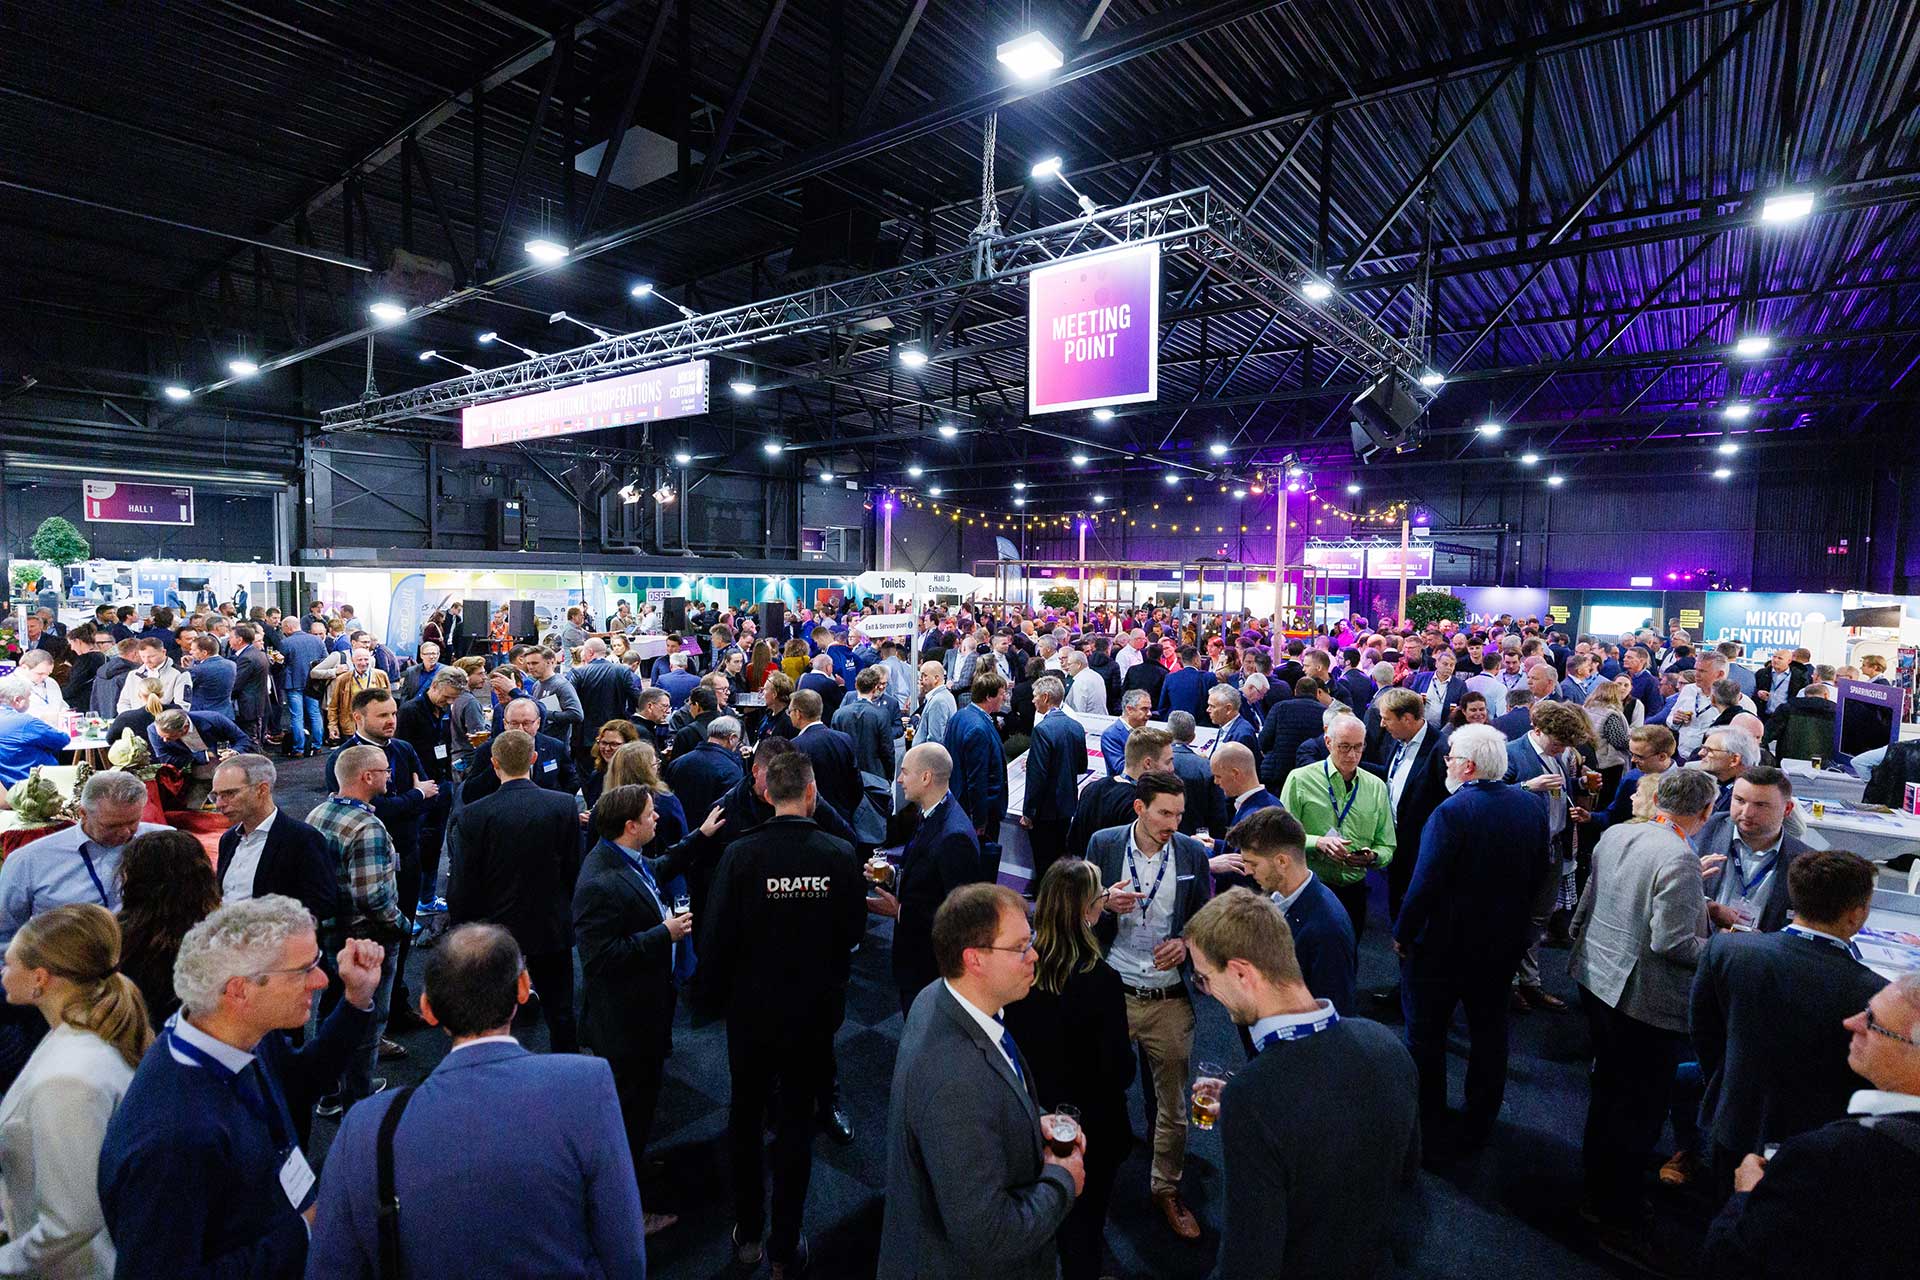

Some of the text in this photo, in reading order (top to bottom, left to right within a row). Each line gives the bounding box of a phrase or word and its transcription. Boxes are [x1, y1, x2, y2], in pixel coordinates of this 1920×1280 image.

[1052, 303, 1131, 342] MEETING
[1064, 332, 1118, 364] POINT
[591, 380, 662, 412] COOPERATIONS
[128, 504, 153, 513] HALL 1
[881, 577, 906, 589] Toilets
[933, 574, 951, 583] Hall 3
[928, 585, 958, 593] Exhibition
[879, 622, 895, 630] Service
[1746, 610, 1802, 628] MIKRO
[1719, 627, 1801, 646] CENTRUM
[1849, 685, 1888, 701] SPARRINGSVELD
[766, 876, 831, 892] DRATEC
